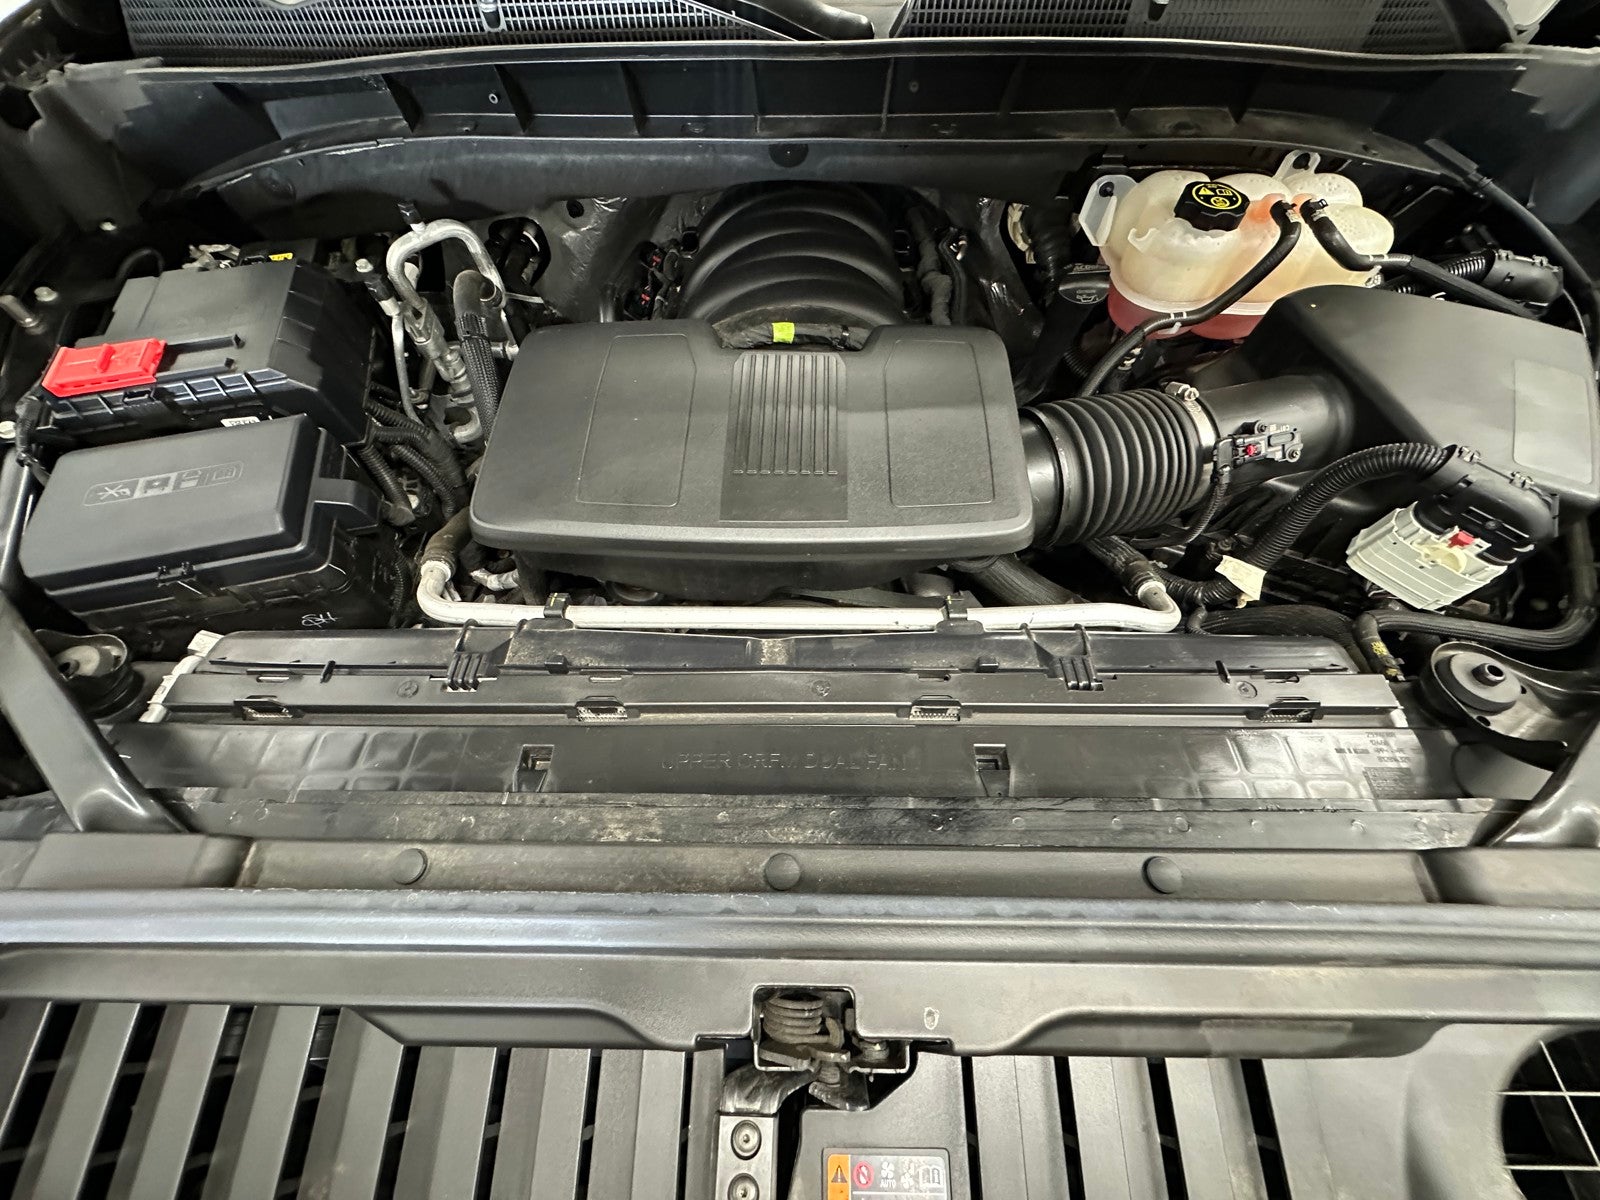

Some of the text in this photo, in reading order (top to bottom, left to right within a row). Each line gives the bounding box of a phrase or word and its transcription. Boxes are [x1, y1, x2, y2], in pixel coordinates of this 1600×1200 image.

[661, 753, 732, 770] UPPER
[804, 753, 861, 770] DUAL
[880, 1179, 897, 1189] AUTO
